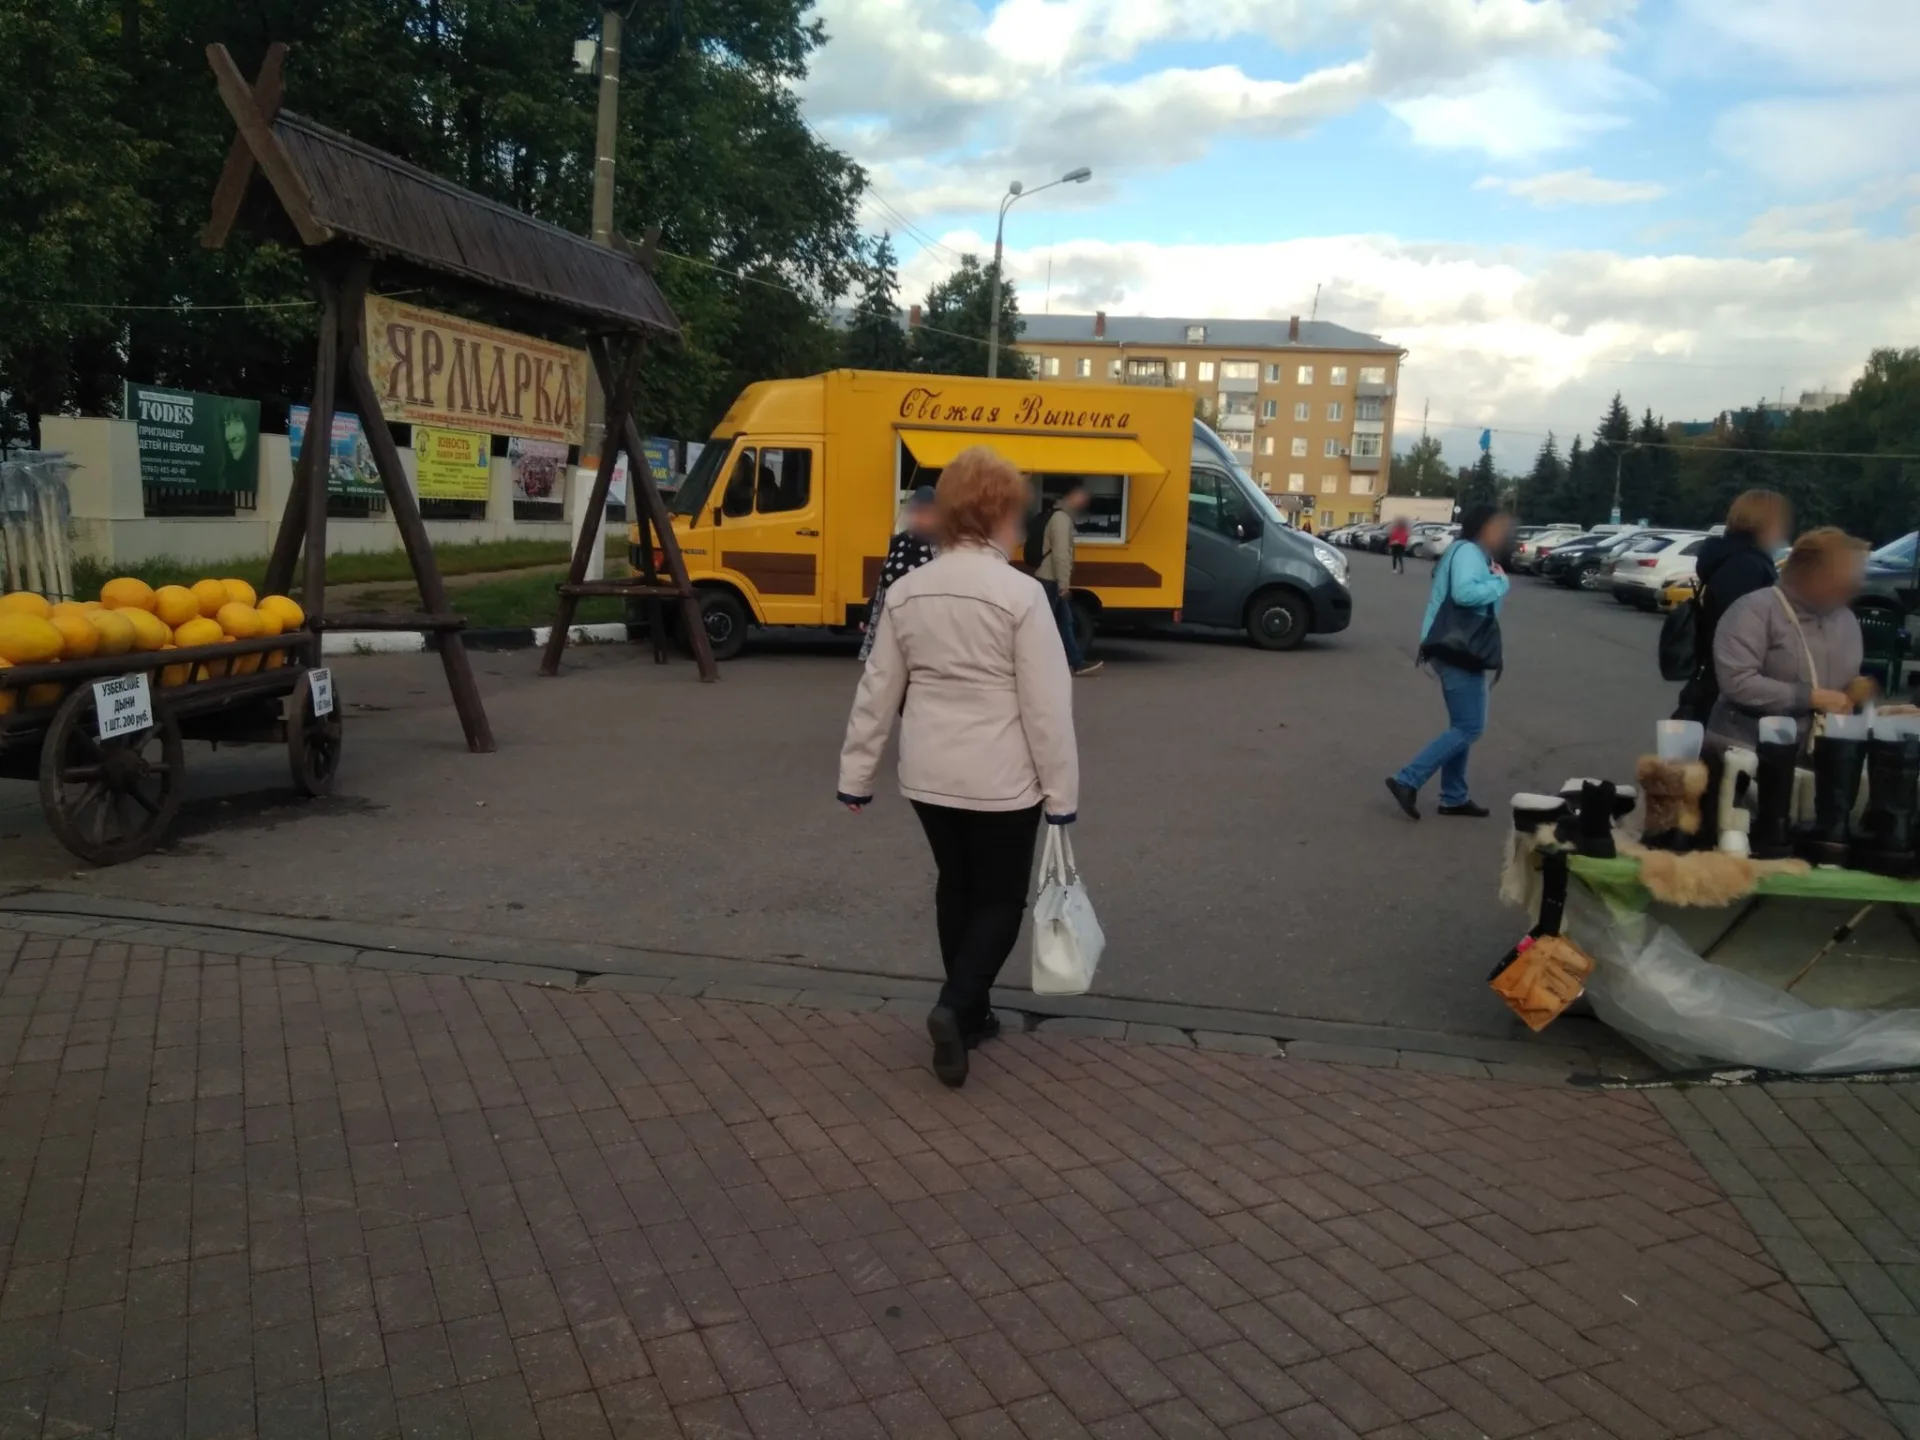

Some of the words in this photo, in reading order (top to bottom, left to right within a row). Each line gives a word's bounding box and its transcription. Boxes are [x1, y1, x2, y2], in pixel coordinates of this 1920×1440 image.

[386, 322, 574, 429] ЯРМАРКА
[138, 400, 194, 425] TODES
[1014, 392, 1131, 428] Выпечка
[138, 425, 185, 439] ПРИГЛАШАЕТ
[162, 441, 168, 451] И
[169, 442, 205, 454] ВЗРОСЛЫХ
[437, 436, 471, 450] ЮНОСТЬ
[114, 696, 135, 715] ДЫНИ
[104, 720, 108, 732] 1
[122, 713, 135, 728] 200
